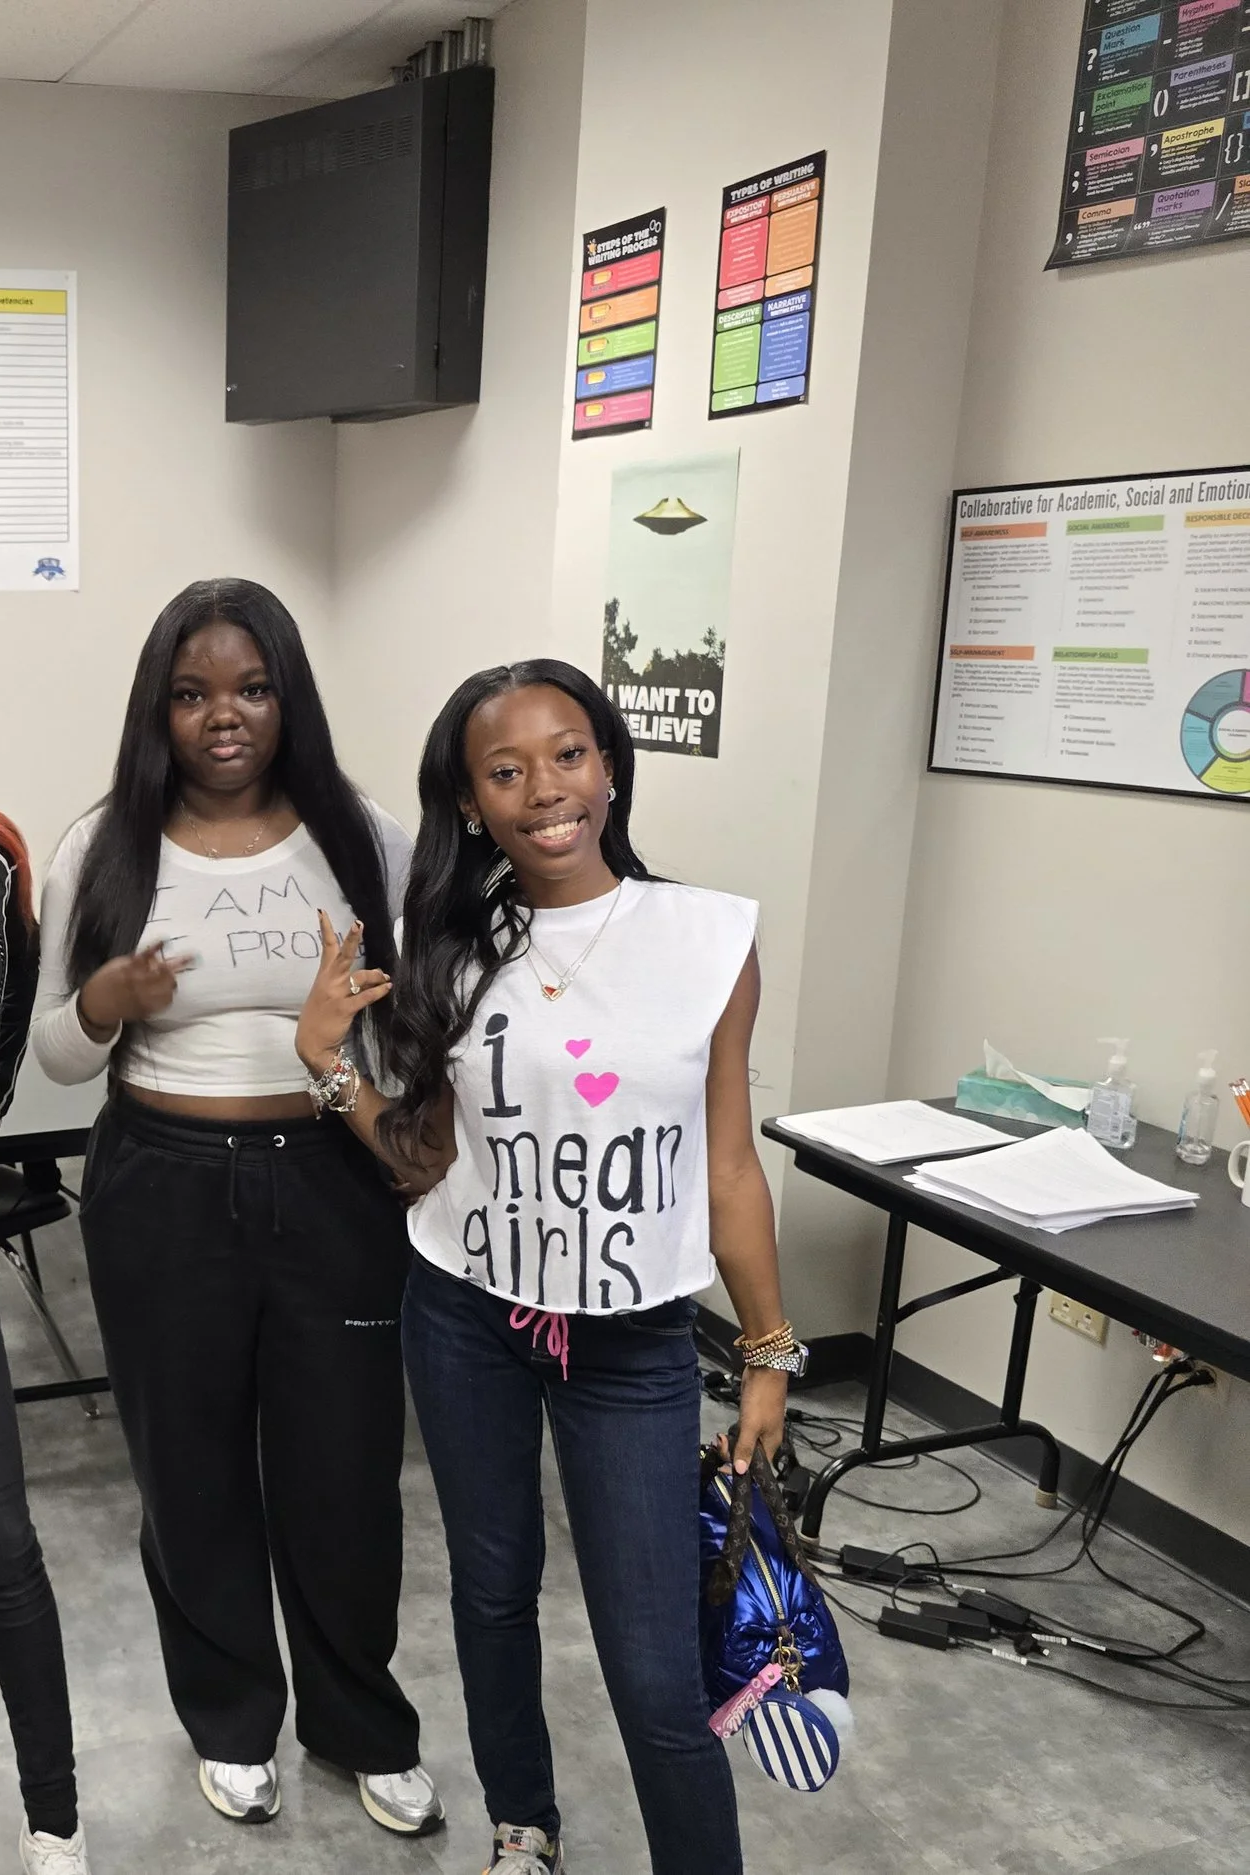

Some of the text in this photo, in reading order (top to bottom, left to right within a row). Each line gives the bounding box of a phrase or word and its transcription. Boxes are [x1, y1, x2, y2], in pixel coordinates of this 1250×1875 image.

[1182, 2, 1215, 17] Hyphen
[1104, 24, 1141, 40] Question
[1103, 37, 1125, 51] Mark
[1173, 60, 1227, 81] Parentheses
[1097, 82, 1147, 101] Exclamation
[1095, 100, 1116, 113] point
[1164, 125, 1215, 144] Apostrophe
[1089, 146, 1130, 162] Semicolon
[731, 163, 815, 201] TYPES OF WRITING
[773, 181, 816, 203] PERSUASIVE
[1157, 187, 1201, 203] Quotation
[726, 199, 767, 219] EXPOSITORY
[1081, 207, 1112, 220] Comma
[1155, 202, 1183, 214] marks
[597, 228, 650, 253] STEPS OF THE
[588, 236, 658, 266] WRITING PROCESS
[768, 294, 806, 311] NARRATIVE
[719, 307, 760, 323] DESCRIPTIVE
[959, 479, 1250, 519] Collaborative for Academic, Social and Emotion
[1185, 510, 1250, 523] RESPONSIBLE DECI
[607, 684, 716, 716] I WANT TO
[146, 875, 311, 923] I AM
[482, 1012, 522, 1118] i
[486, 1124, 683, 1213] mean
[463, 1202, 643, 1310] girls
